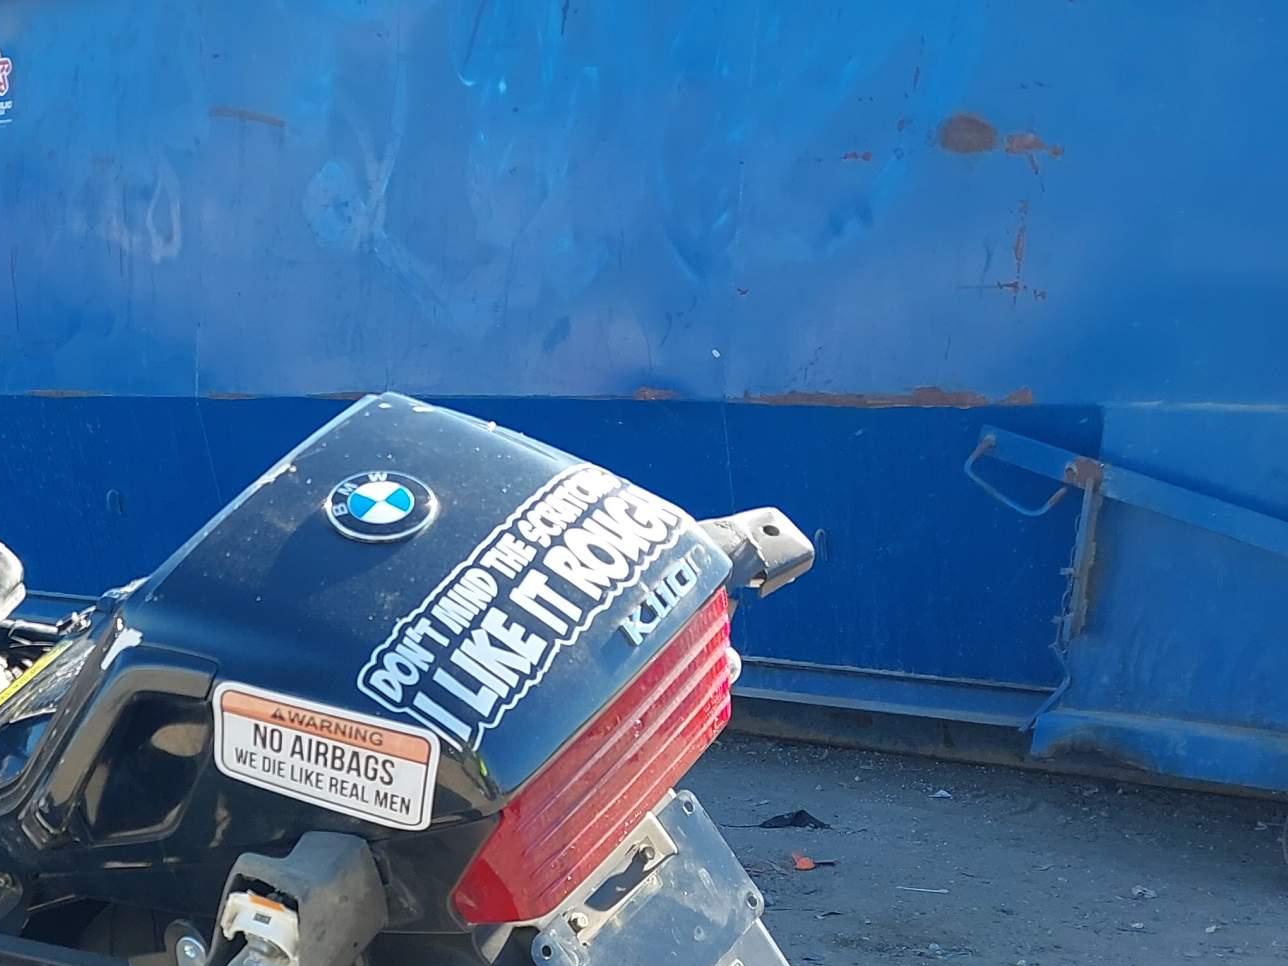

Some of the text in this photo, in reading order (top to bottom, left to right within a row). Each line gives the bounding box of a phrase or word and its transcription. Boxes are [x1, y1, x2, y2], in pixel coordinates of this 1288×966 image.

[332, 471, 388, 518] BMW
[370, 619, 450, 703] DON'T
[431, 569, 499, 634] MIND
[481, 532, 537, 581] THE
[509, 567, 583, 635] IT
[433, 608, 547, 718] LIKE
[288, 710, 384, 747] WARNING
[414, 692, 472, 742] I
[234, 747, 412, 816] WE DIE LIKE REAL MEN
[253, 723, 396, 787] NO AIRBAGS
